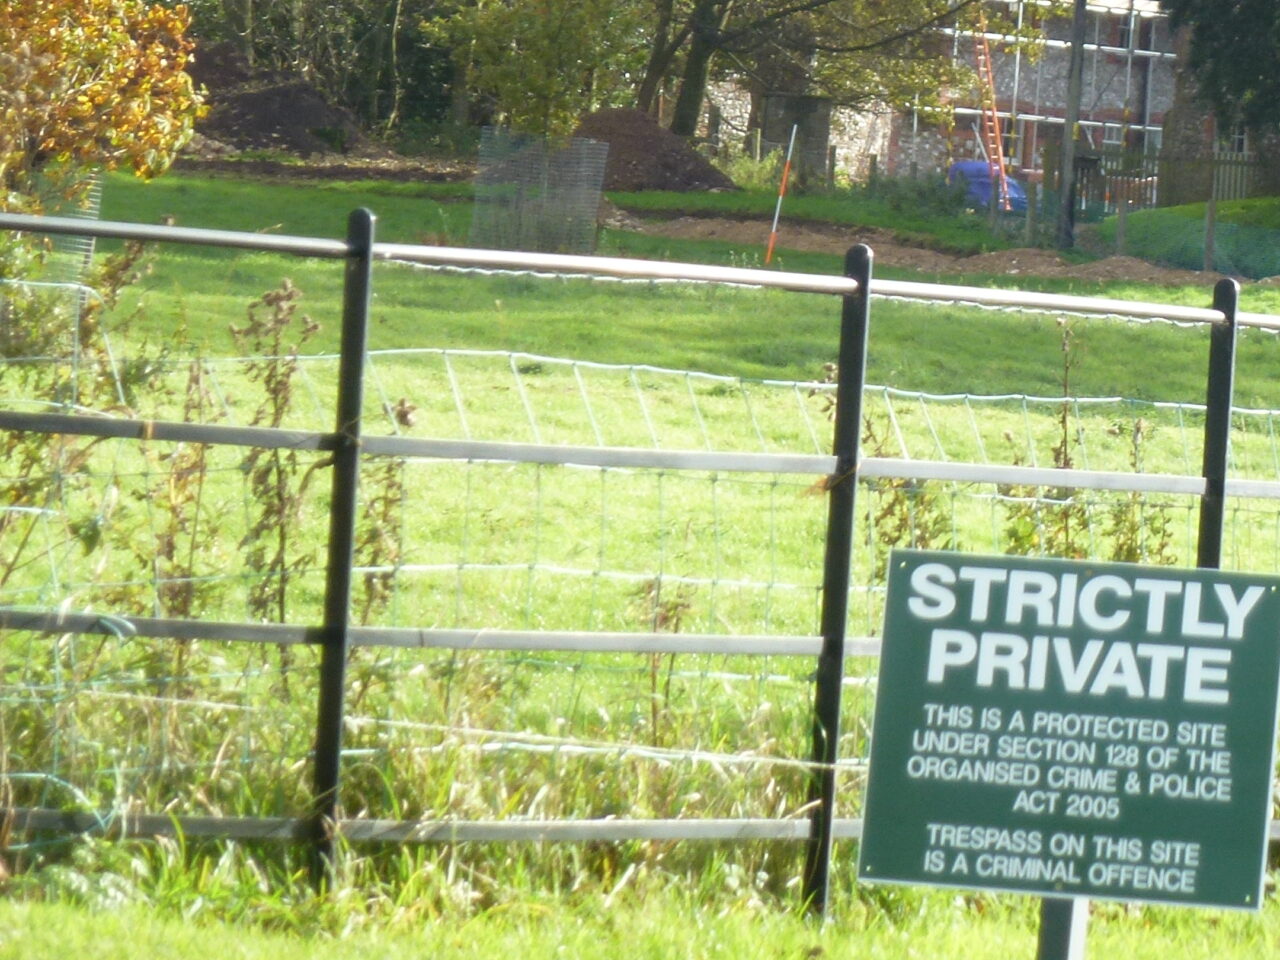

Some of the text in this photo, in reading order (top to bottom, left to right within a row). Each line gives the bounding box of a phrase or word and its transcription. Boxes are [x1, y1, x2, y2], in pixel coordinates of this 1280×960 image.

[908, 563, 1266, 640] STRICTLY
[927, 629, 1232, 705] PRIVATE
[924, 704, 1226, 747] THIS IS A PROTECTED SITE
[913, 730, 1231, 774] UNDER SECTION 128 OF THE
[906, 756, 1232, 801] ORGANISED CRIME & POLICE
[1013, 790, 1120, 819] ACT 2005
[927, 824, 1200, 866] TRESPASS ON THIS SITE
[924, 850, 1195, 893] IS A CRIMINAL OFFENCE
